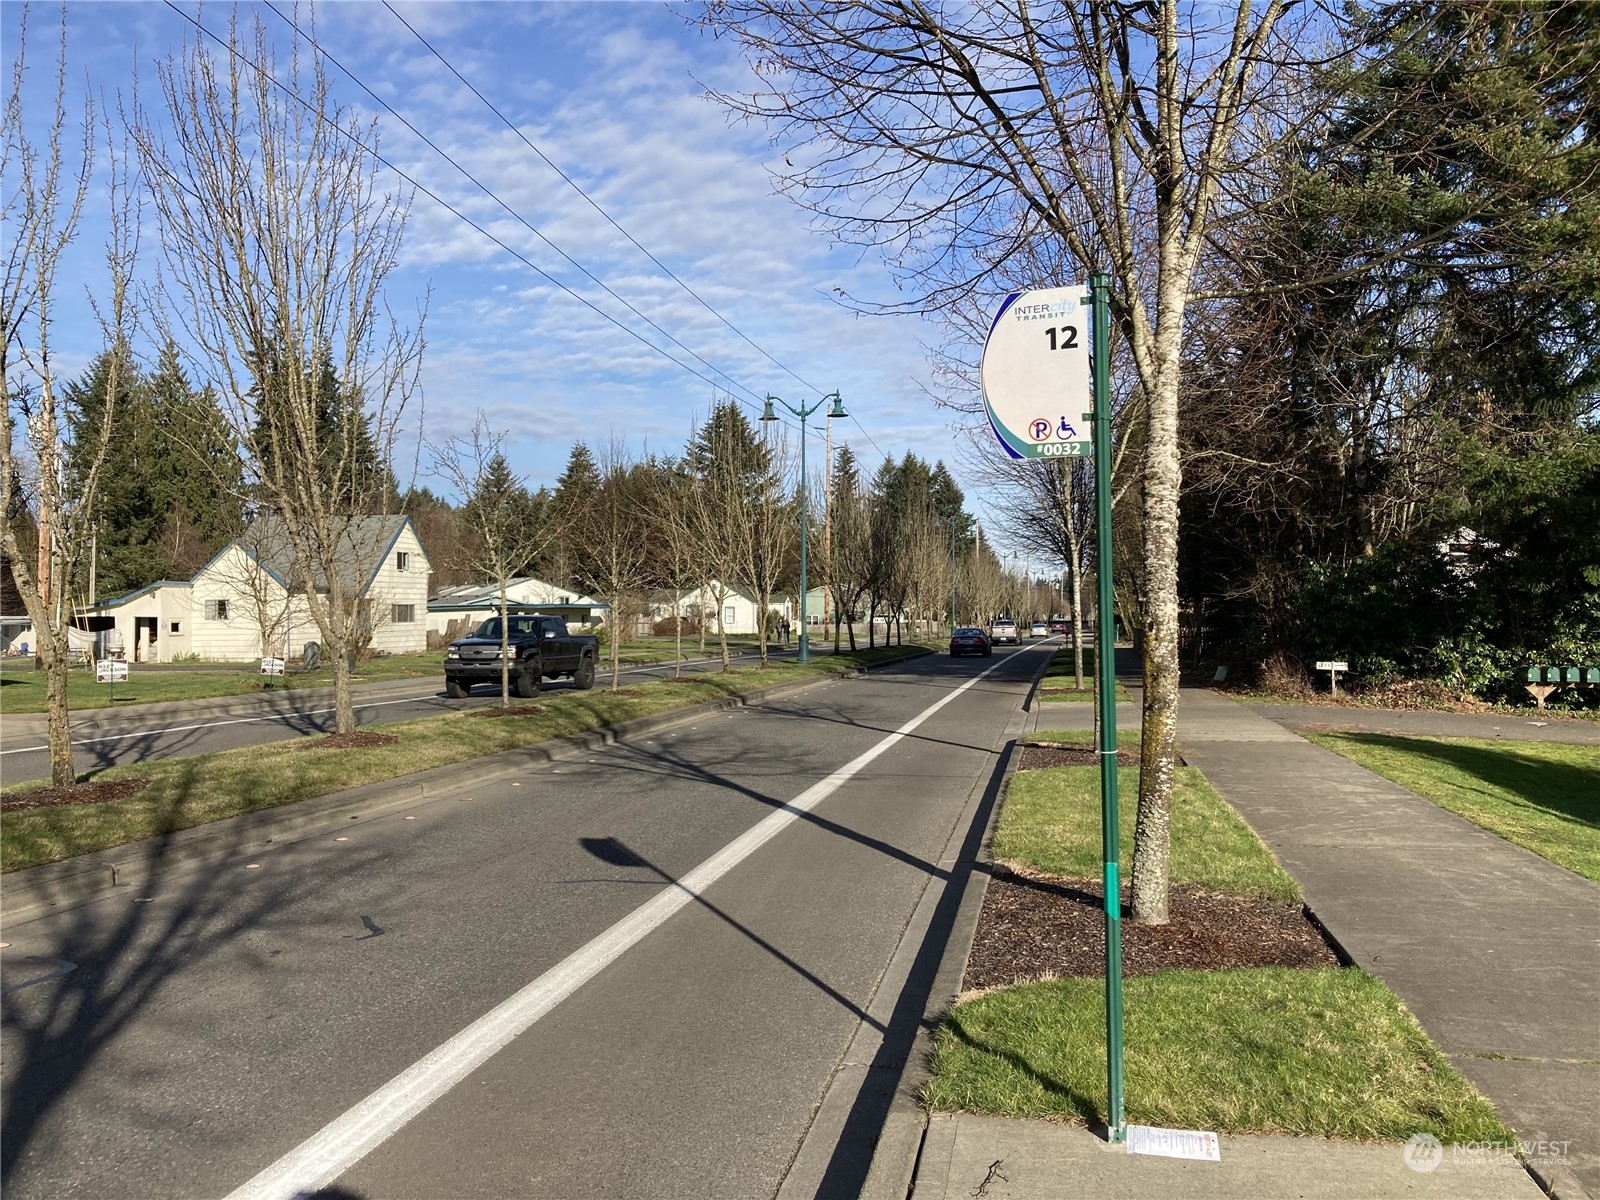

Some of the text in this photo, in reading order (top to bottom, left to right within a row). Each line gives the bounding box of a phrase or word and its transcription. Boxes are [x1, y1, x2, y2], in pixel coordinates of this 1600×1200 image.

[1016, 312, 1065, 321] TRANSIT
[1045, 325, 1078, 350] 12
[1037, 443, 1080, 456] #0032
